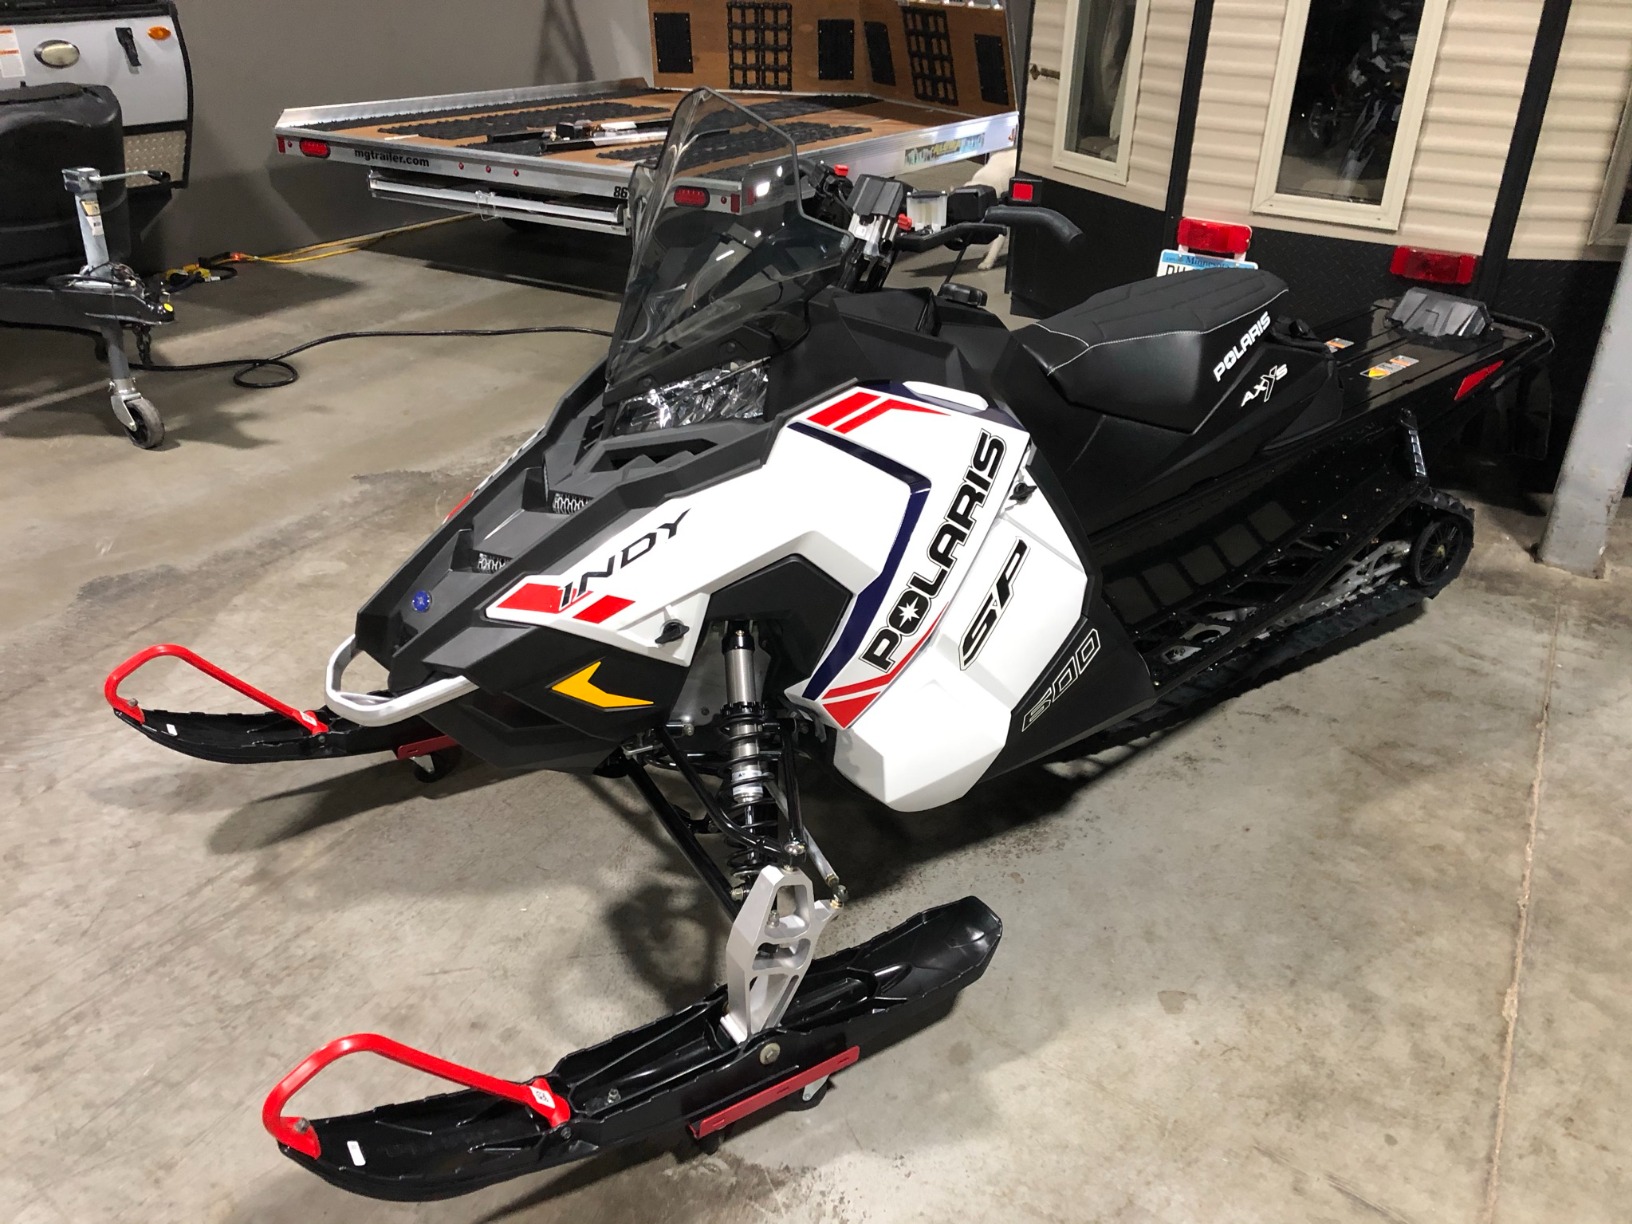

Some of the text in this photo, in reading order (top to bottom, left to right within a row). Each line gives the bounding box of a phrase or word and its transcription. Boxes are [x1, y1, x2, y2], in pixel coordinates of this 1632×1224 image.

[355, 149, 430, 167] mgtrailer.com
[1213, 311, 1271, 382] POLARIS
[560, 508, 692, 608] INDY
[859, 428, 1007, 673] POLARIS
